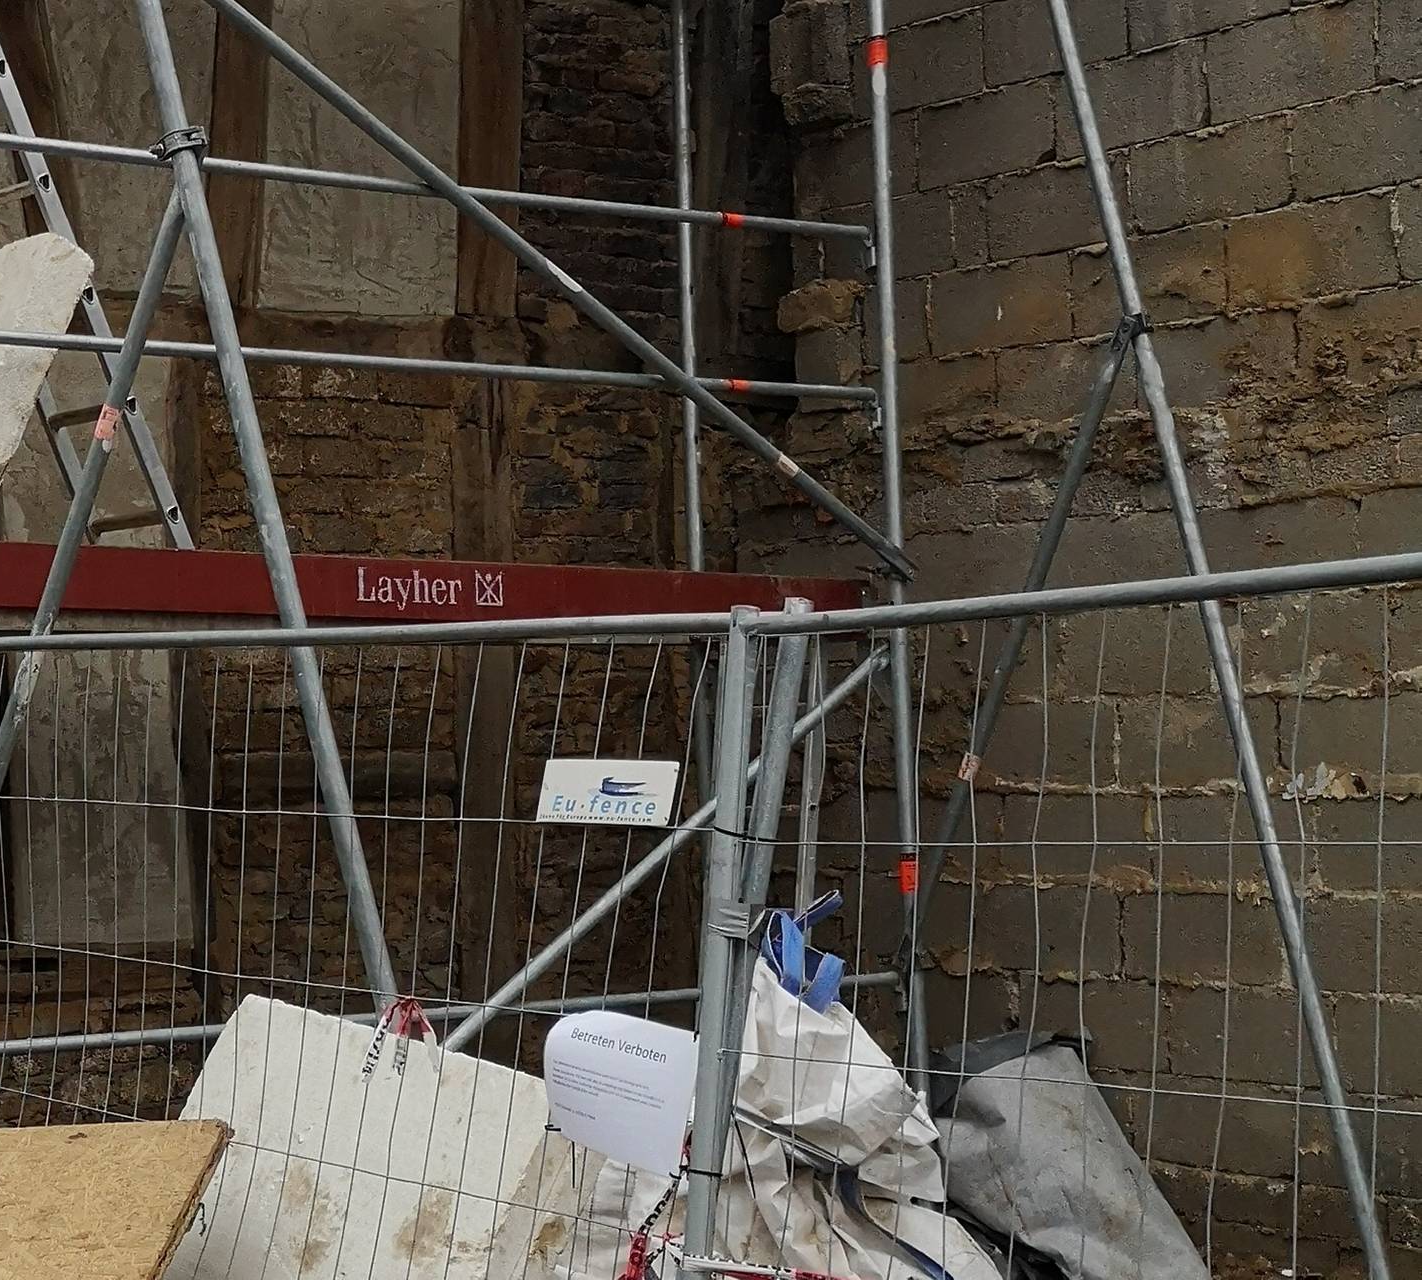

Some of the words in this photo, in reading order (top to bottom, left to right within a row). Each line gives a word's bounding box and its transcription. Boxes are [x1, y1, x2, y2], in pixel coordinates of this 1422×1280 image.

[357, 566, 463, 611] Layher
[571, 1027, 615, 1050] Betreten
[618, 1039, 667, 1063] Verboten
